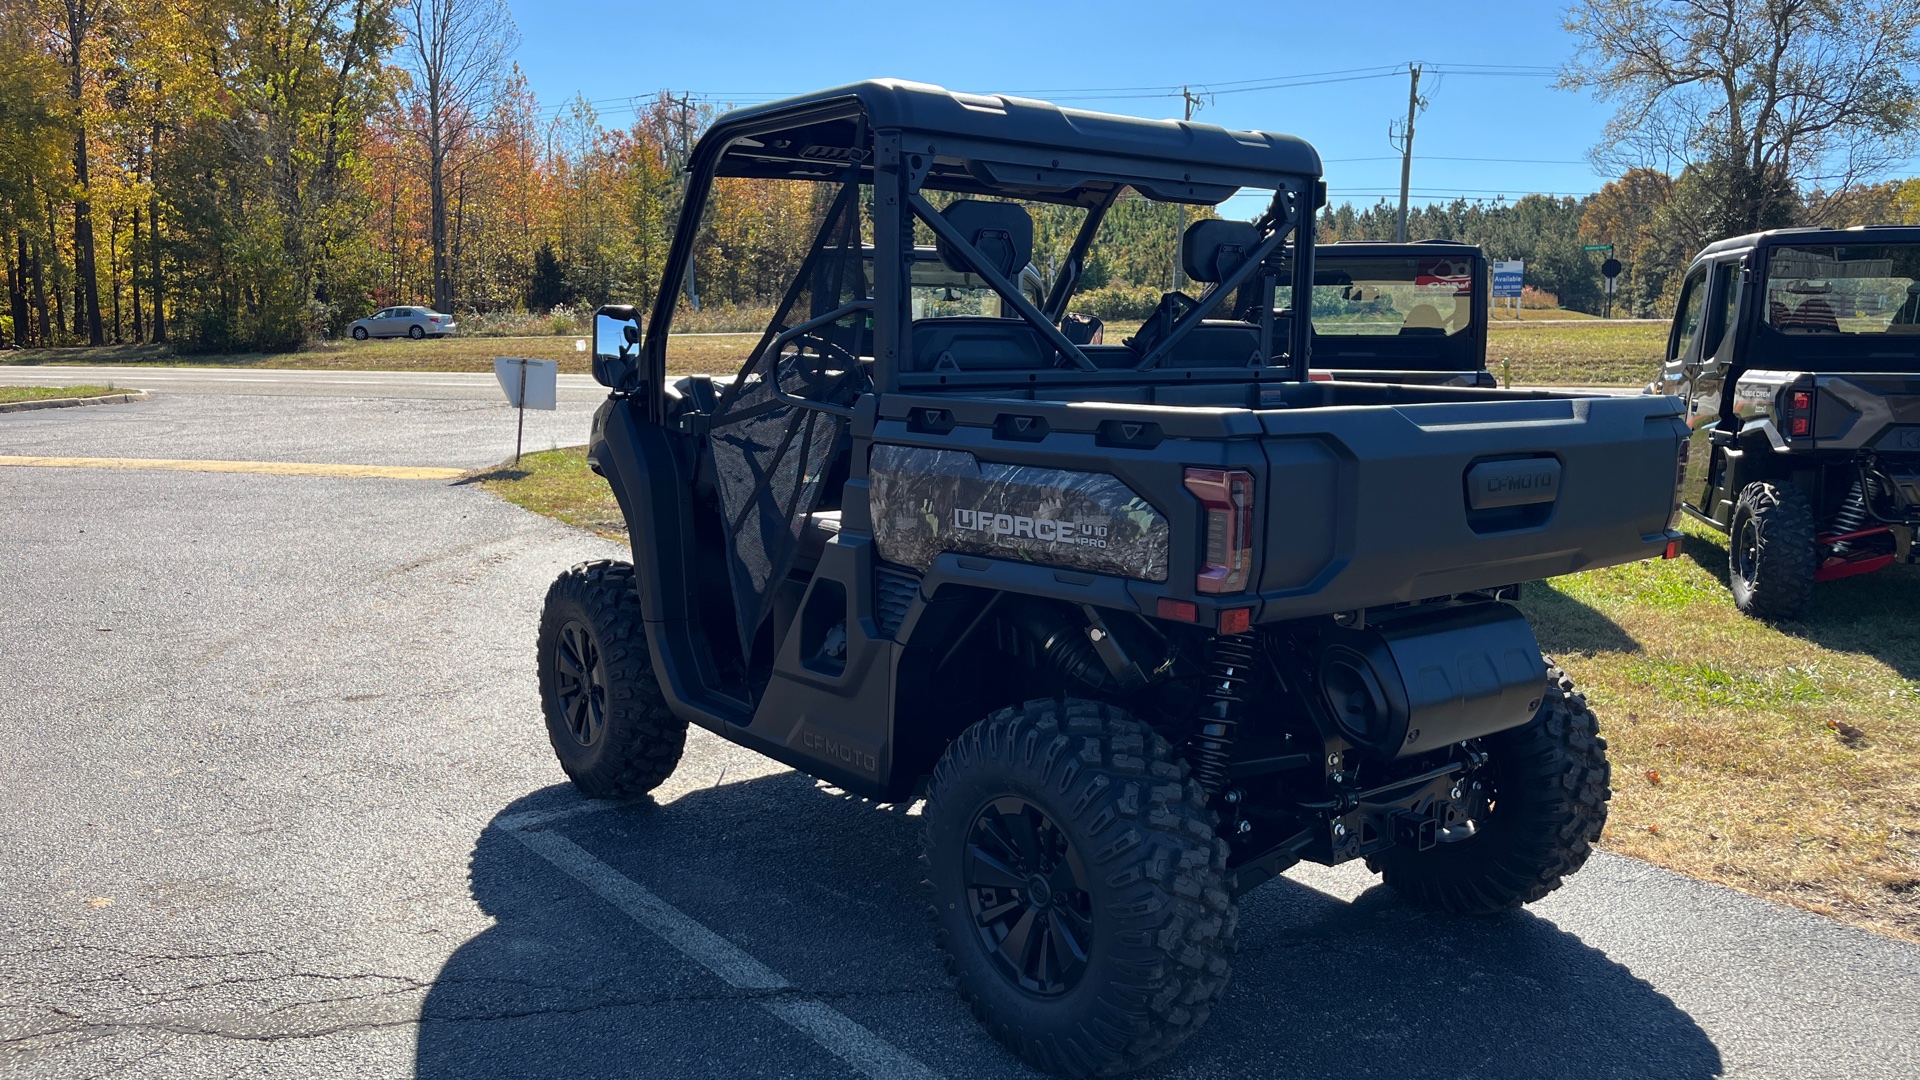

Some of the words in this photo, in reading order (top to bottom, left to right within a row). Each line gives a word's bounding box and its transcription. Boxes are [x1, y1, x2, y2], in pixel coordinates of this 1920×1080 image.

[1487, 471, 1552, 492] CFMOTO
[954, 508, 1075, 544] UFORCE
[1080, 537, 1107, 549] PRO
[802, 730, 876, 772] CFMOTO
